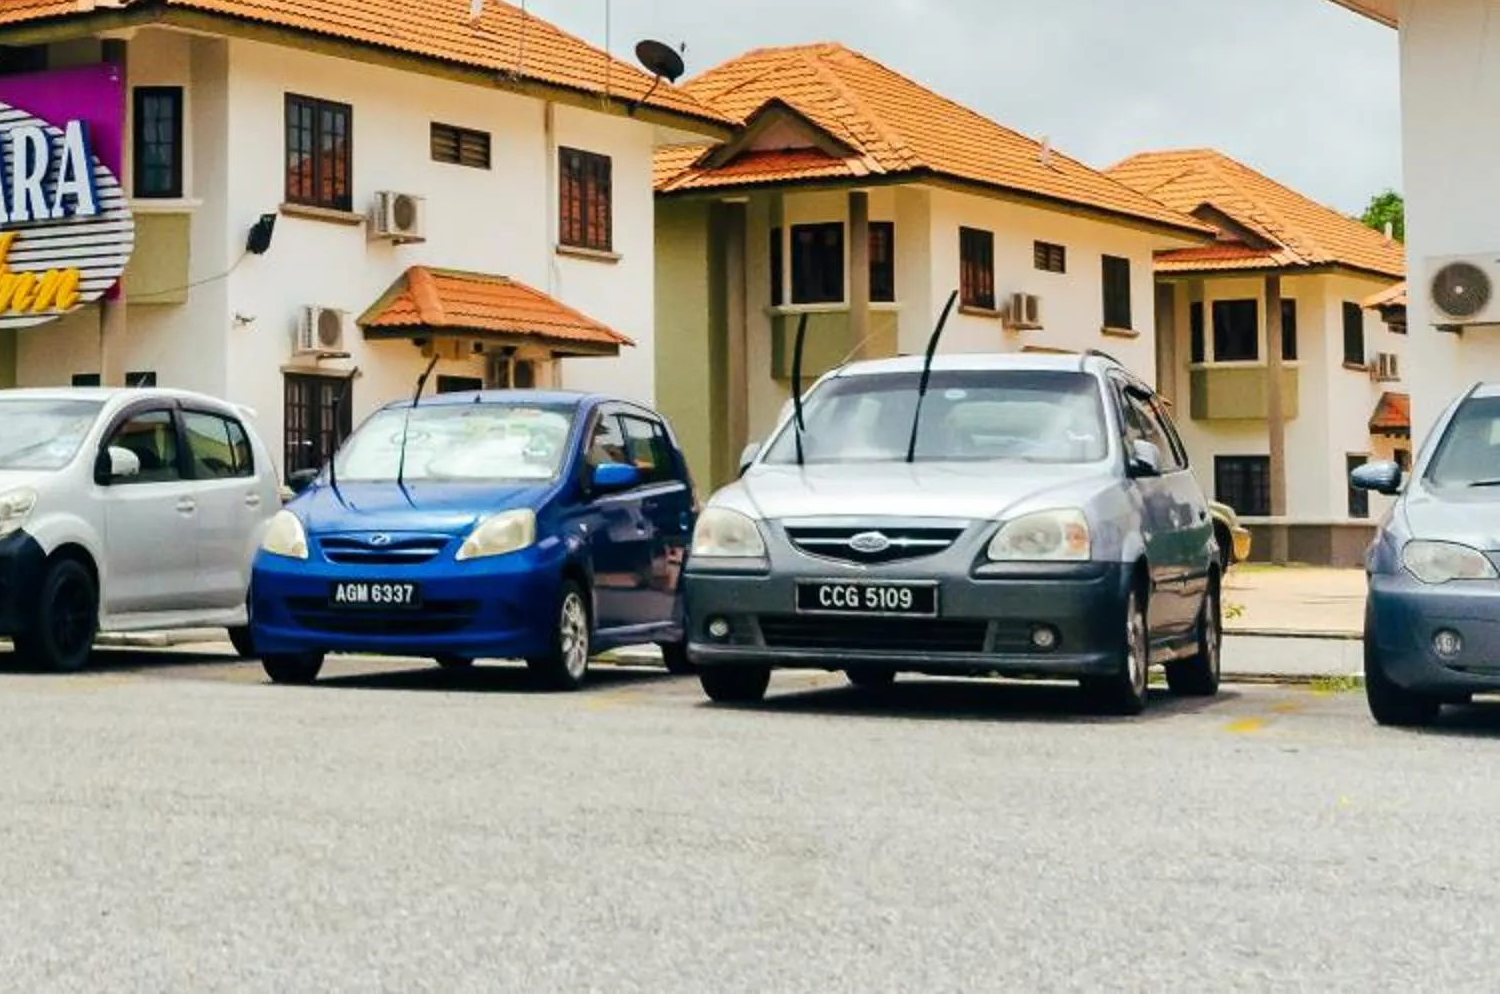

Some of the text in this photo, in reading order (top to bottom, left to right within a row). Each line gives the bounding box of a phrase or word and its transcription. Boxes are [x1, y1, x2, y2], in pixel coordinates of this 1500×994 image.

[335, 583, 414, 603] AGM 6337
[819, 585, 912, 609] CCG 5109
